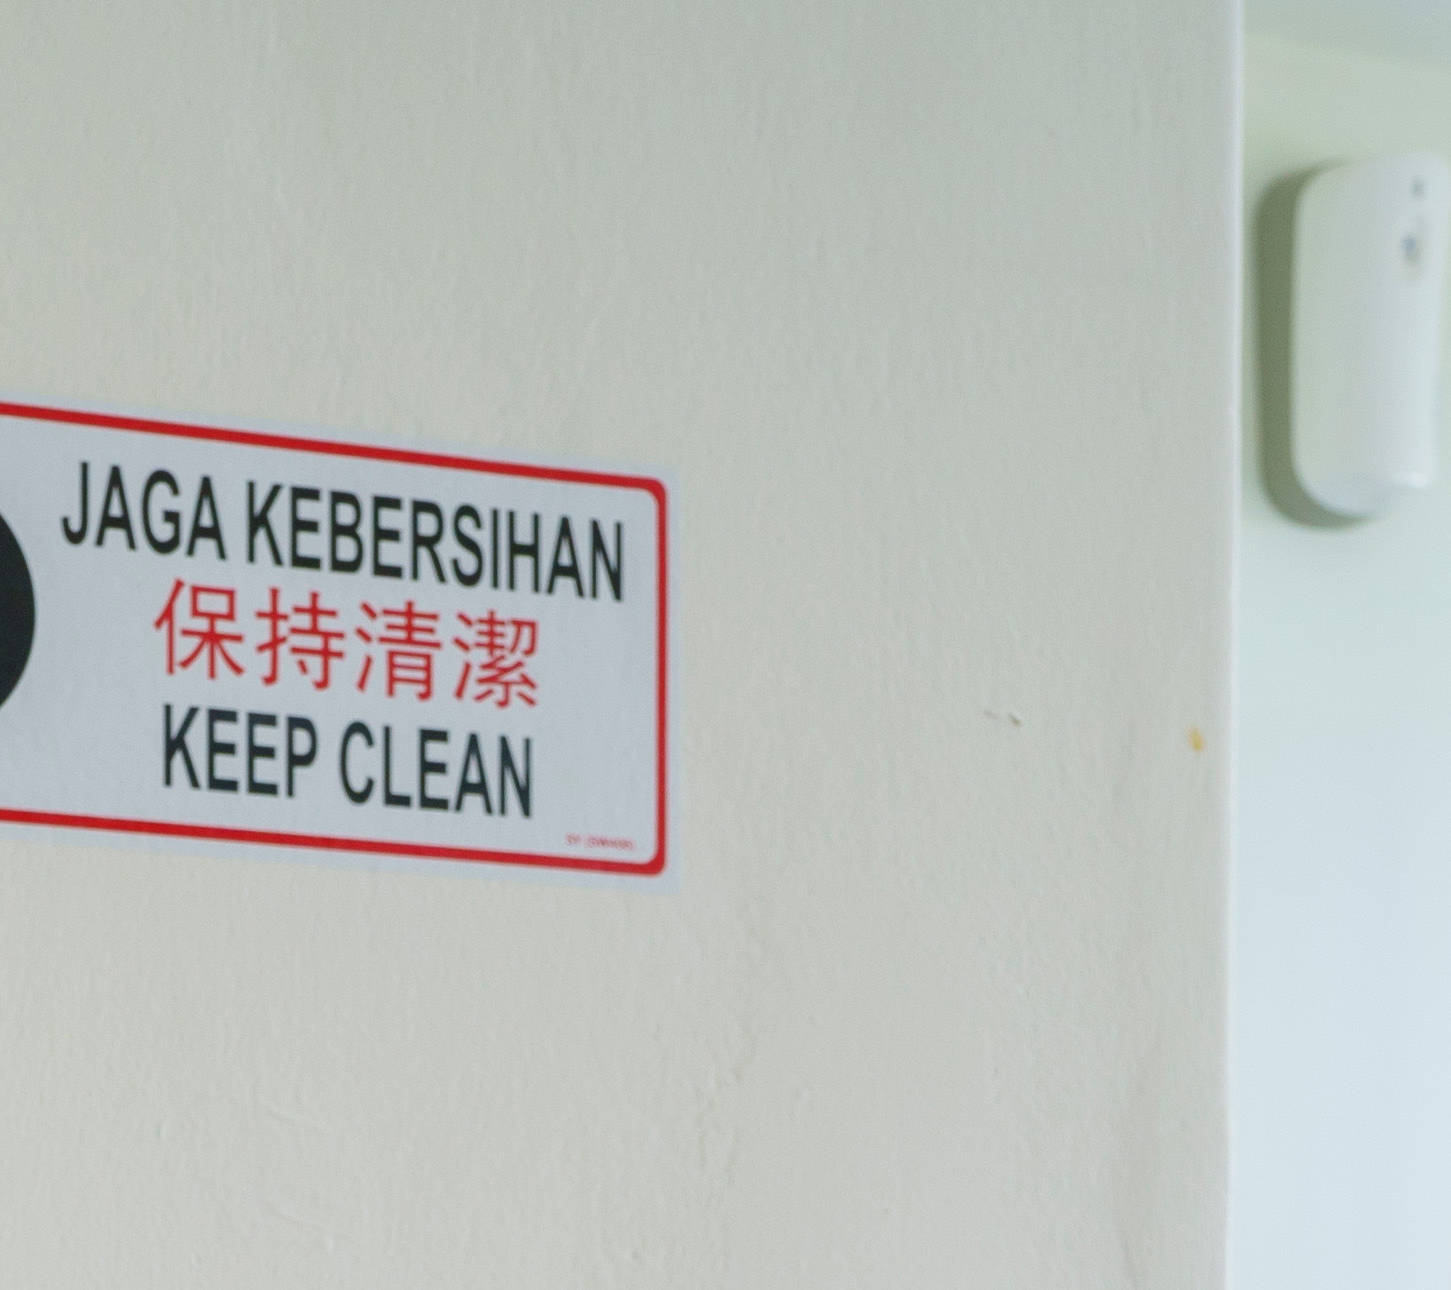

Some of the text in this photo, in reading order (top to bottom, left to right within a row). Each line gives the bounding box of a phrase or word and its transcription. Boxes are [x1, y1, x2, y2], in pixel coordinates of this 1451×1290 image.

[61, 461, 622, 602] JAGA KEBERSIHAN
[154, 579, 537, 708] 保持清潔
[164, 704, 531, 818] KEEP CLEAN
